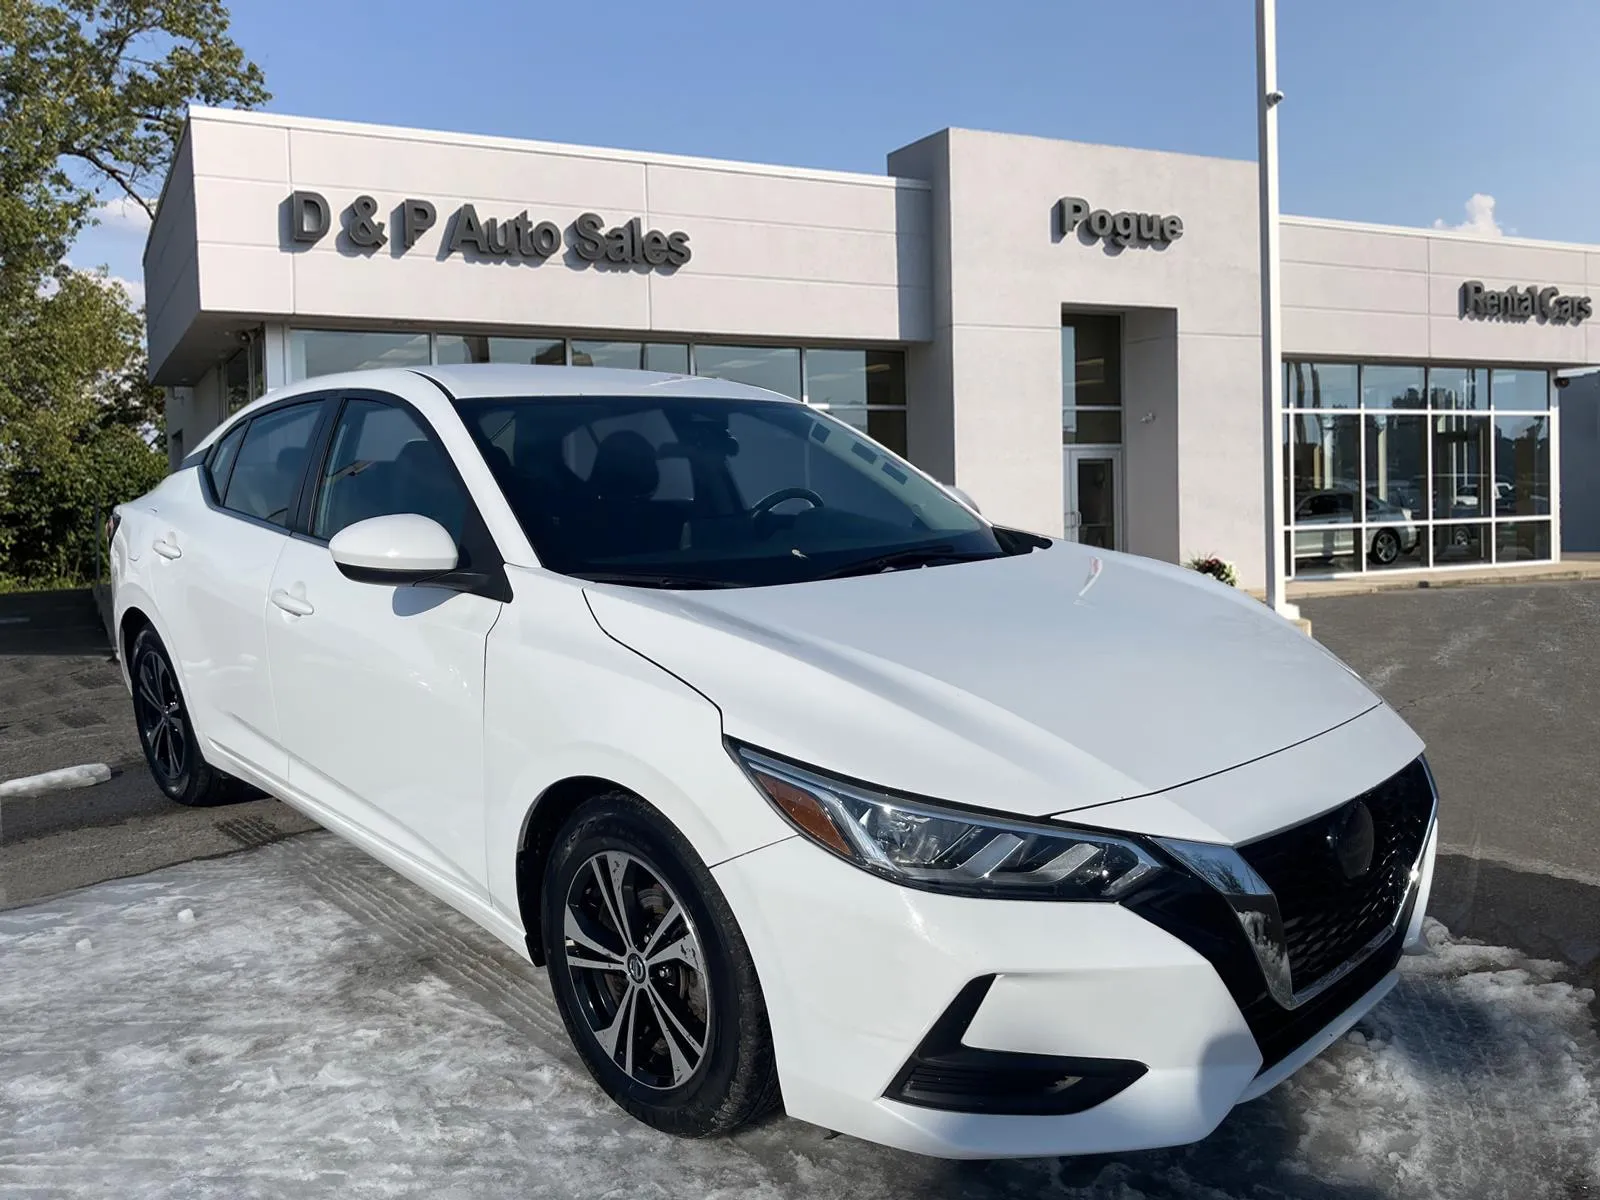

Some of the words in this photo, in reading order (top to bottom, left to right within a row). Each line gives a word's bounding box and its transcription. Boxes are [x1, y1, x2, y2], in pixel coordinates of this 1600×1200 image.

[293, 190, 331, 243] D
[348, 195, 388, 247] &
[402, 198, 436, 247] P
[449, 204, 562, 258] Auto
[573, 212, 692, 271] Sales
[1059, 196, 1184, 247] Pogue
[1462, 280, 1538, 317] Rental
[1540, 286, 1592, 322] Cars
